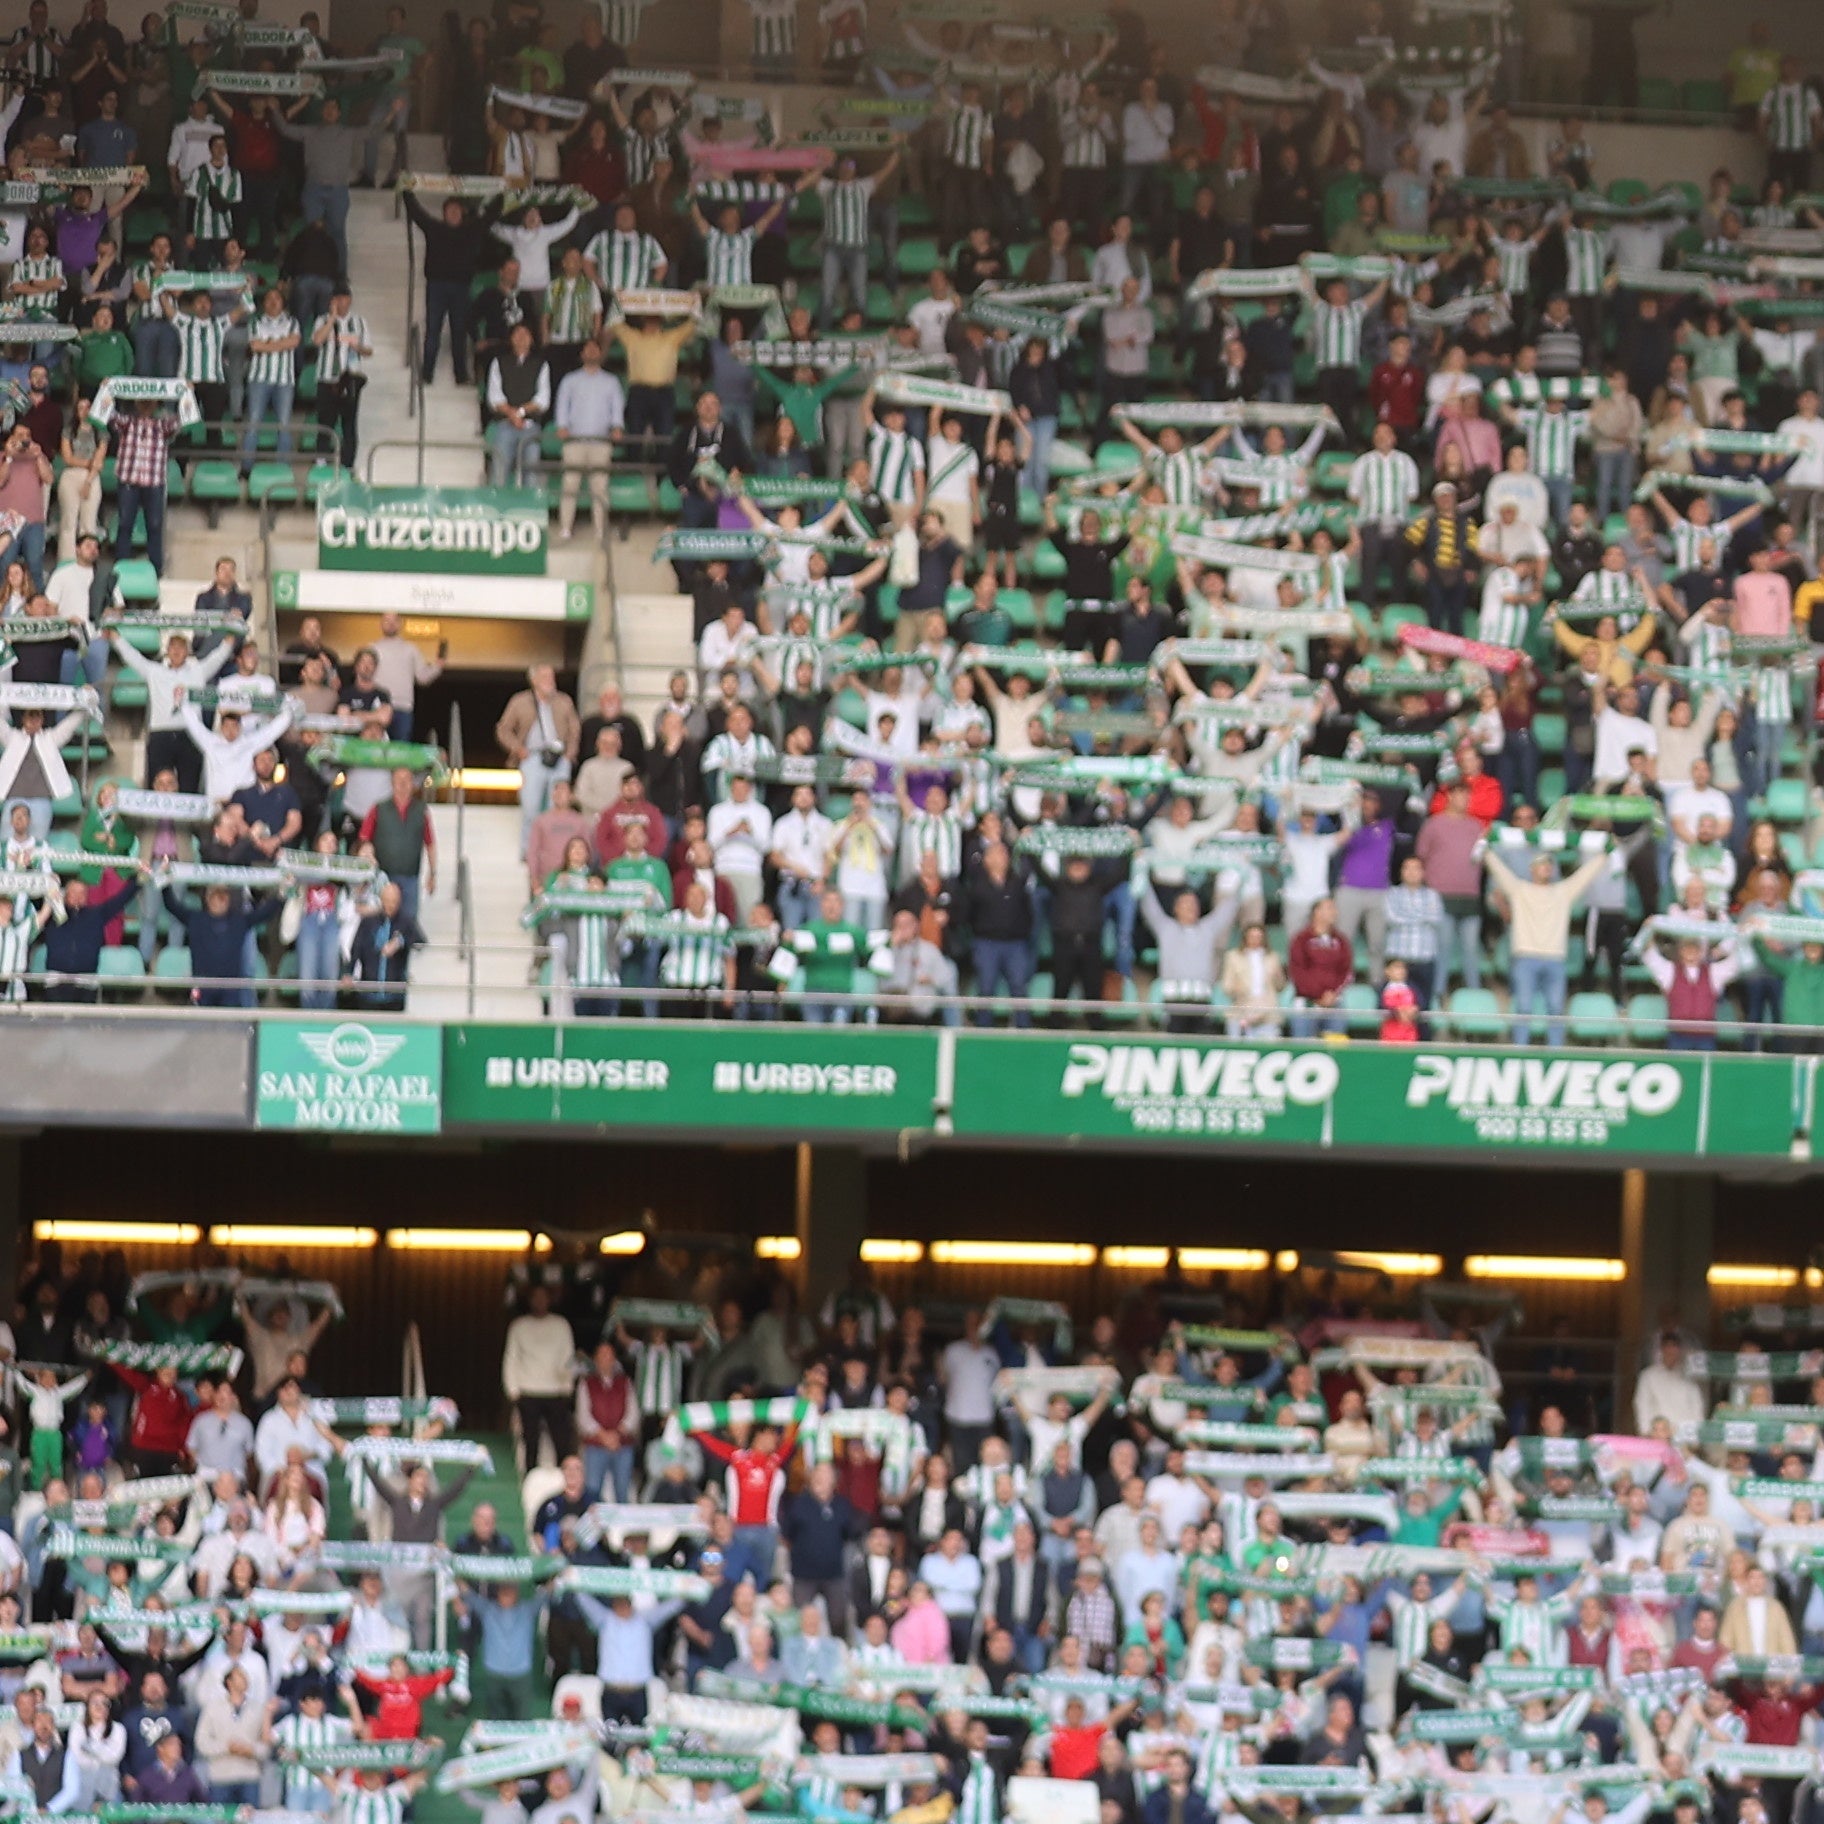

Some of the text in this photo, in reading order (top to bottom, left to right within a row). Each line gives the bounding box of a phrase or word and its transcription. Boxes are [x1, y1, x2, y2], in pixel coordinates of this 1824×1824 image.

[321, 505, 541, 558] Cruzcampo
[259, 1071, 438, 1102] SAN RAFAEL
[515, 1056, 670, 1090] URBYSER
[744, 1060, 897, 1095] URBYSER
[1060, 1043, 1340, 1105] PINVECO
[1406, 1054, 1682, 1116] PINVECO
[295, 1099, 401, 1128] MOTOR
[1131, 1106, 1174, 1132] 900
[1475, 1116, 1517, 1142] 900
